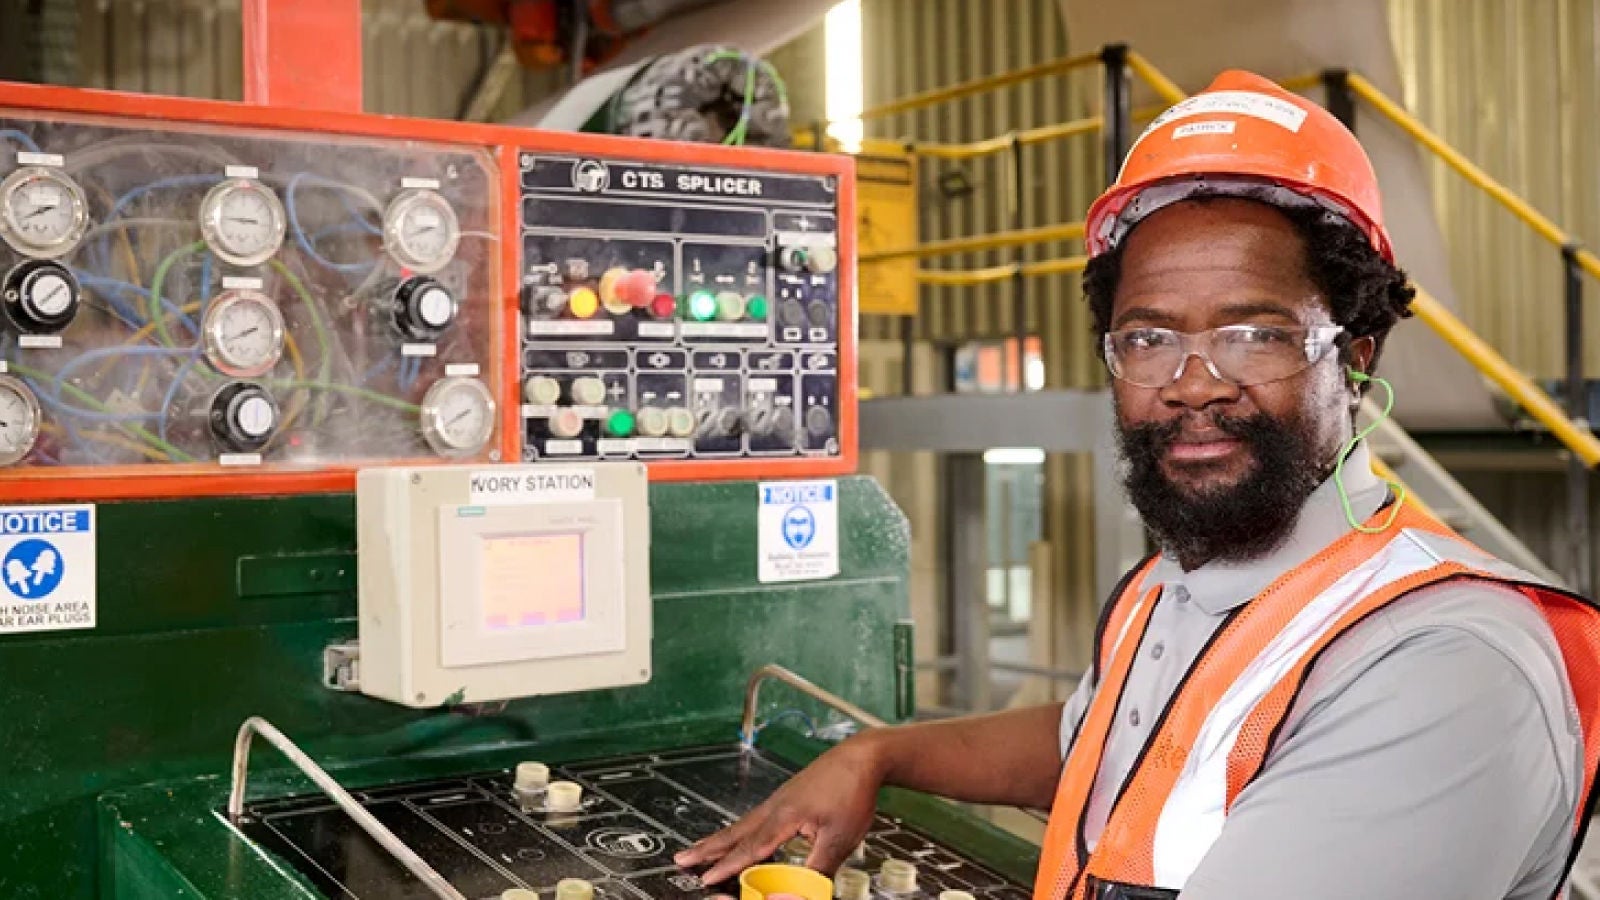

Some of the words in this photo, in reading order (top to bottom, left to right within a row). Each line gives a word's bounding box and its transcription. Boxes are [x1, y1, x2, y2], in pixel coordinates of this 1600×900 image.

[677, 173, 763, 195] SPLICER
[526, 474, 594, 492] STATION
[770, 486, 824, 504] NOTICE
[0, 512, 77, 532] OTICE
[12, 603, 48, 614] NOISE
[55, 602, 89, 612] AREA
[18, 614, 44, 626] EAR
[48, 613, 91, 624] PLUGS
